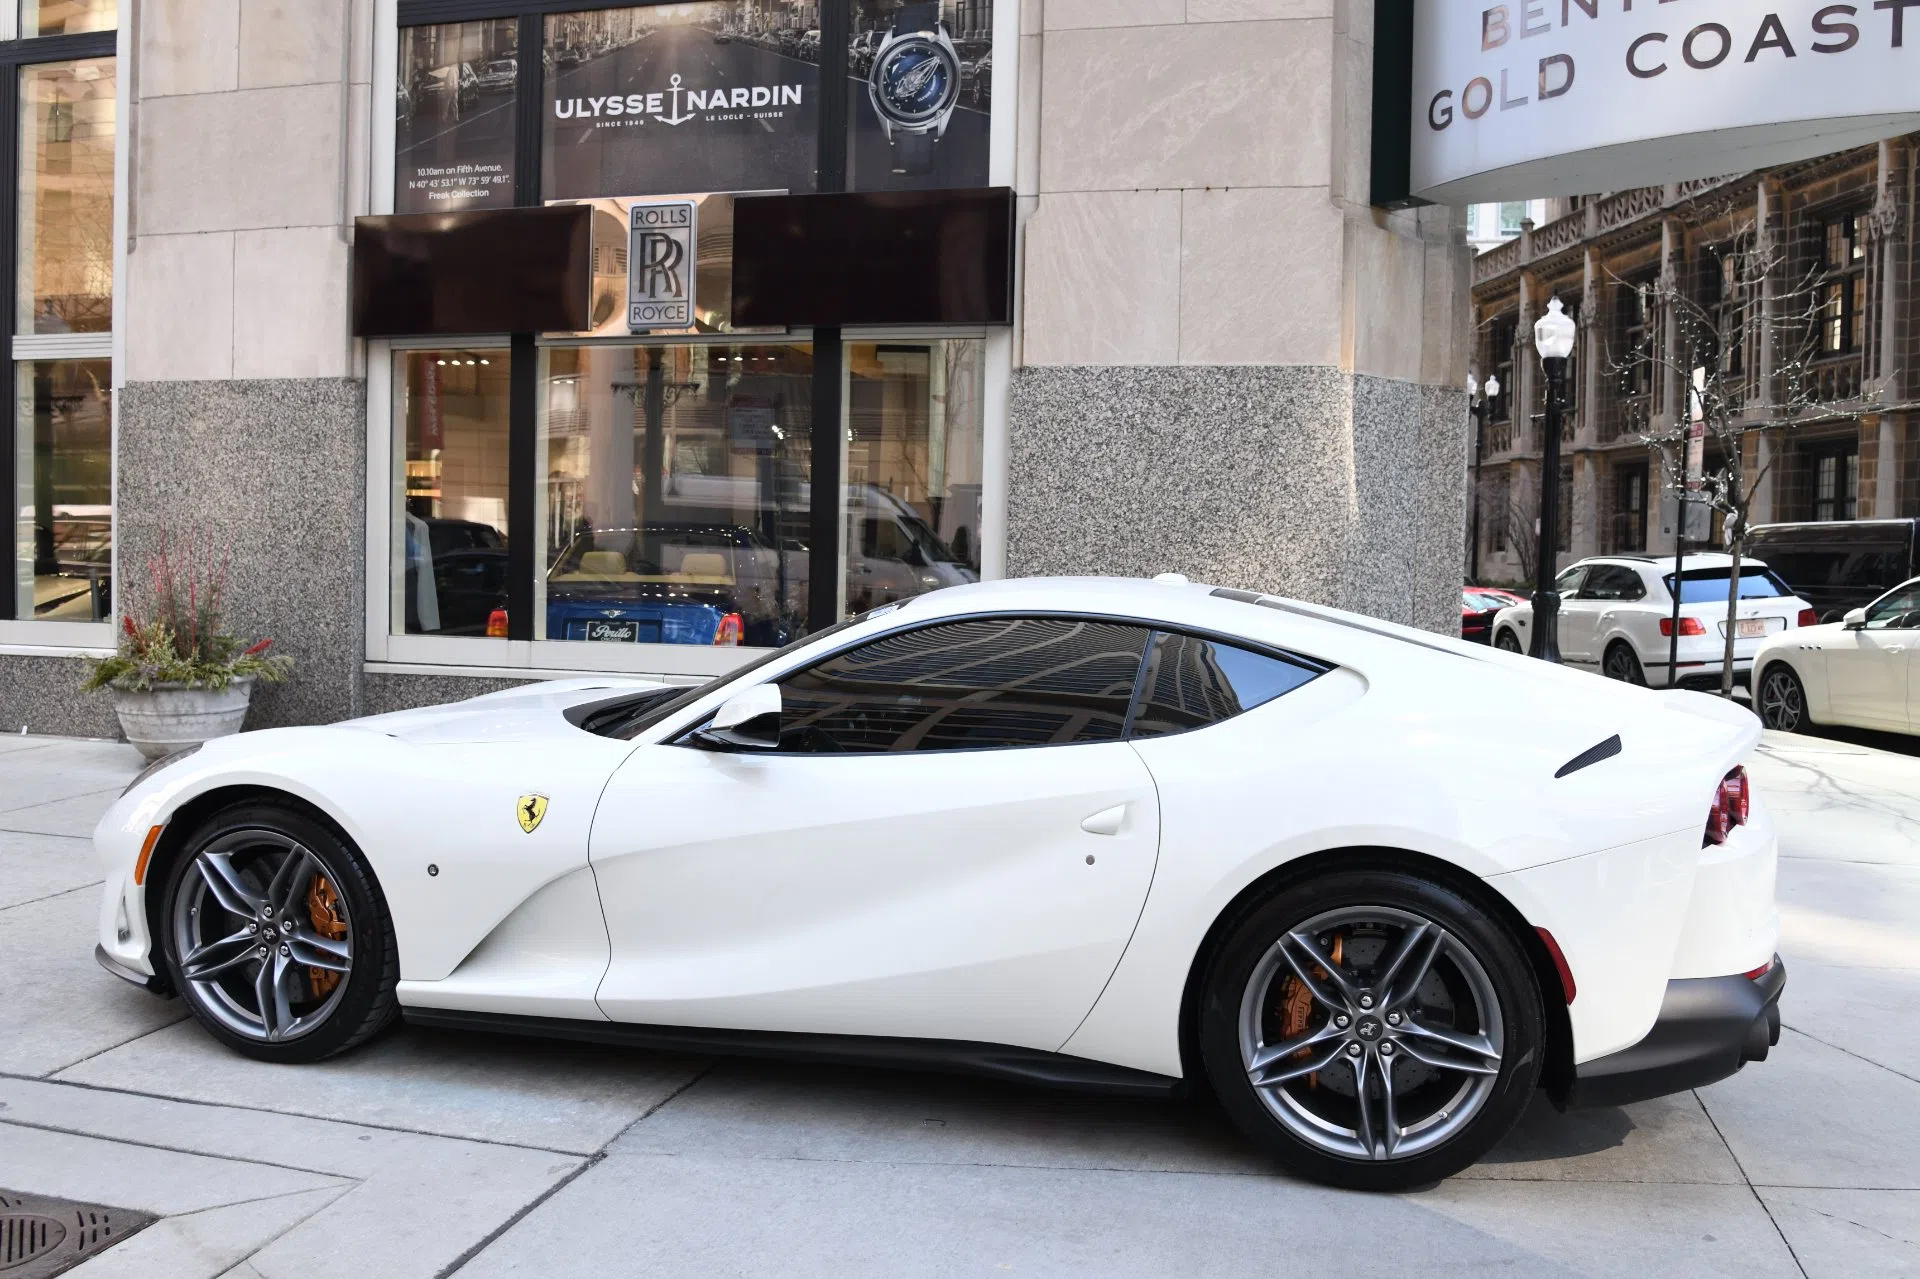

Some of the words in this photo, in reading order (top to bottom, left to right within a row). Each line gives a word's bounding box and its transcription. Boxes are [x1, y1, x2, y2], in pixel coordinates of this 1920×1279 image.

[1428, 53, 1575, 131] GOLD
[1625, 0, 1920, 79] COAST
[555, 92, 664, 119] ULYSSE
[686, 84, 802, 111] NARDIN
[754, 111, 783, 119] SUISSE
[457, 165, 473, 173] Fifth
[409, 181, 415, 189] N
[428, 191, 449, 199] Freak
[451, 189, 489, 198] Collection
[636, 209, 687, 224] ROLLS
[633, 305, 684, 320] ROYCE
